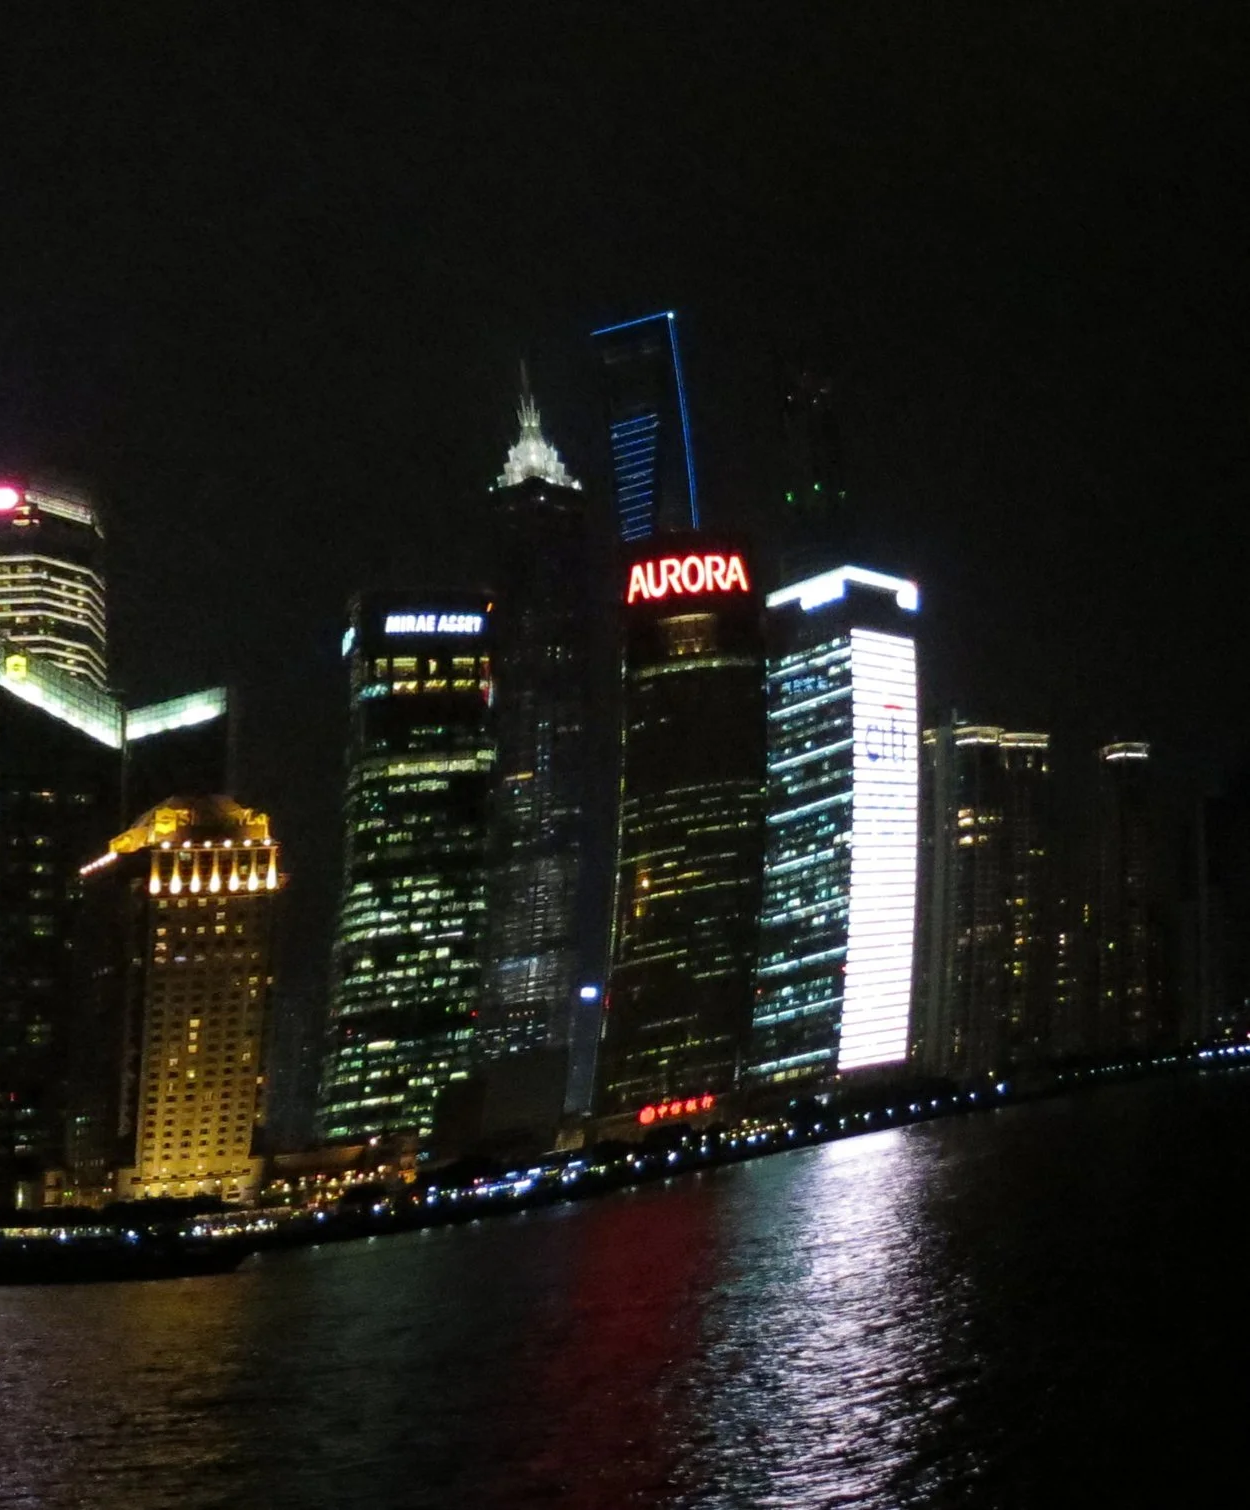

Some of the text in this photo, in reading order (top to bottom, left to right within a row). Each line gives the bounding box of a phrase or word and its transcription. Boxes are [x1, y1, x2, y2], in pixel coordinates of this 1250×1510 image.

[627, 555, 748, 604] AURORA
[385, 614, 482, 633] MIRAE ASSET
